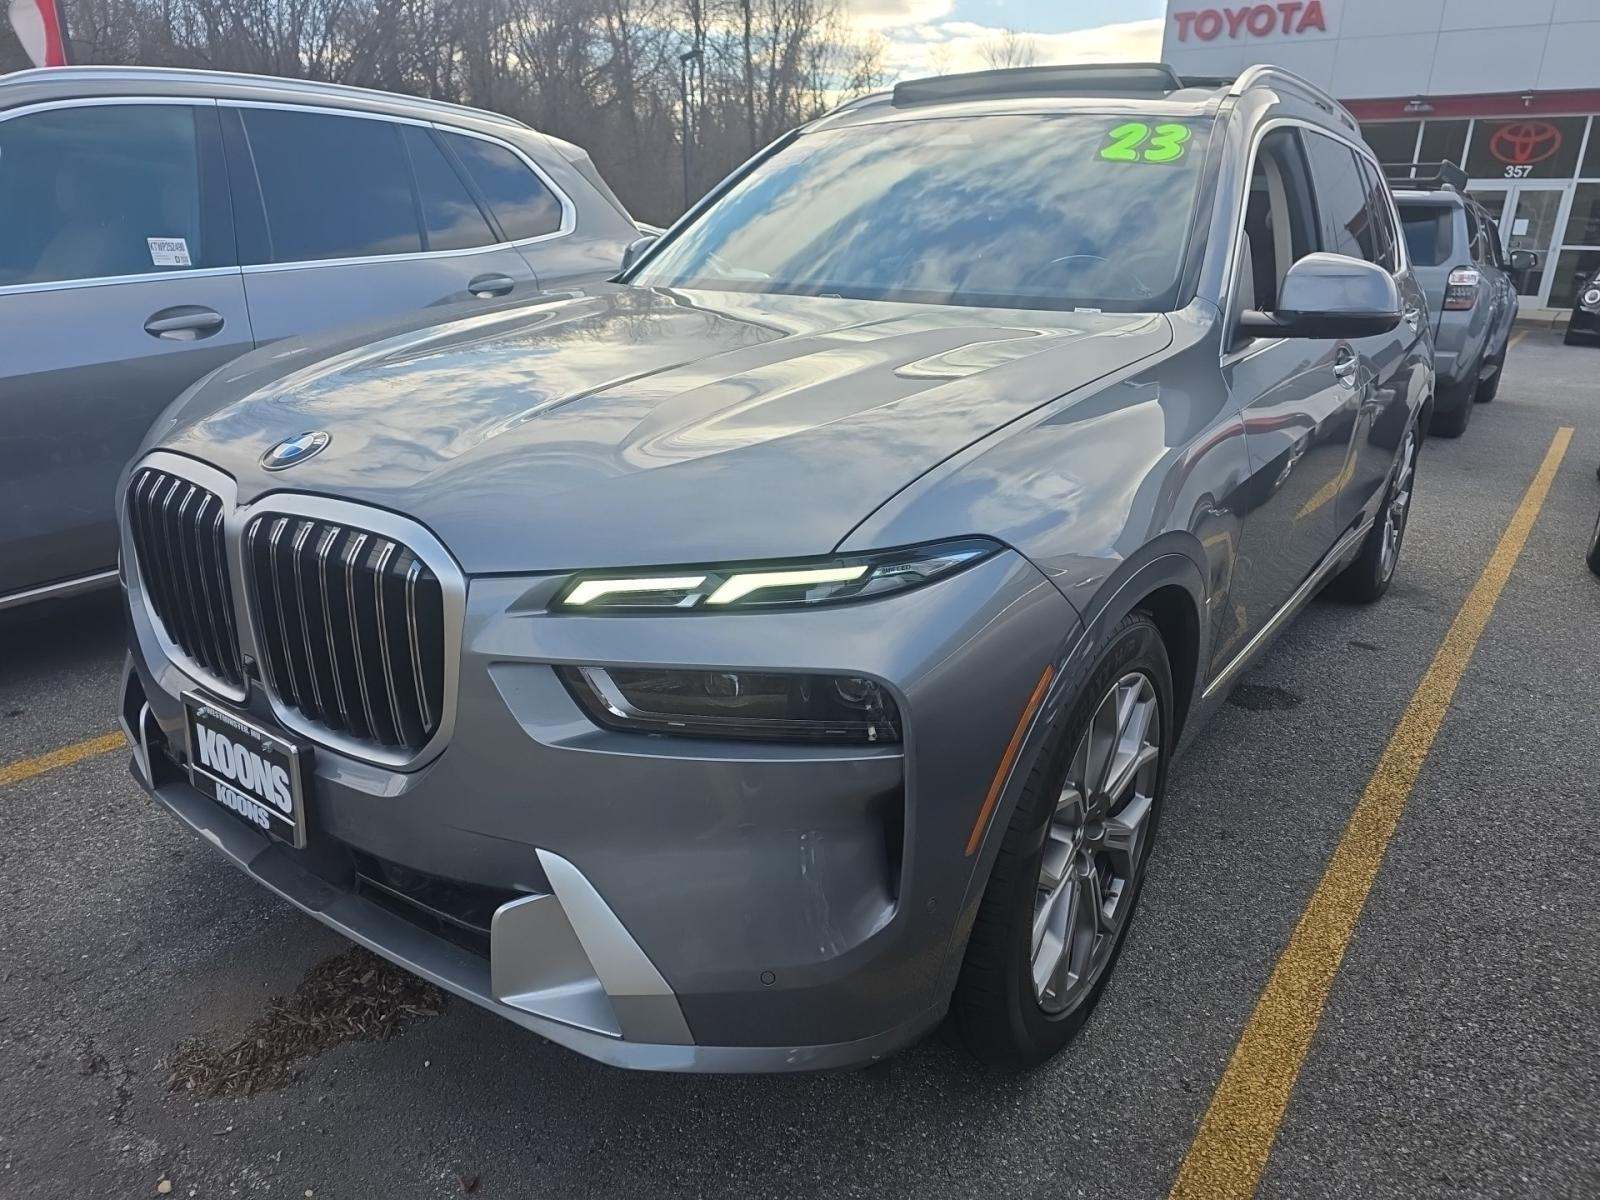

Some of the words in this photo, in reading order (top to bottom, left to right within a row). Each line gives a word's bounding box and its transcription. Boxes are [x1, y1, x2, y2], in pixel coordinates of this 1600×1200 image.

[1174, 1, 1326, 42] TOYOTA
[1101, 123, 1191, 163] 23
[1504, 165, 1533, 178] 357
[196, 723, 292, 814] KOONS
[216, 782, 270, 830] KOONS
